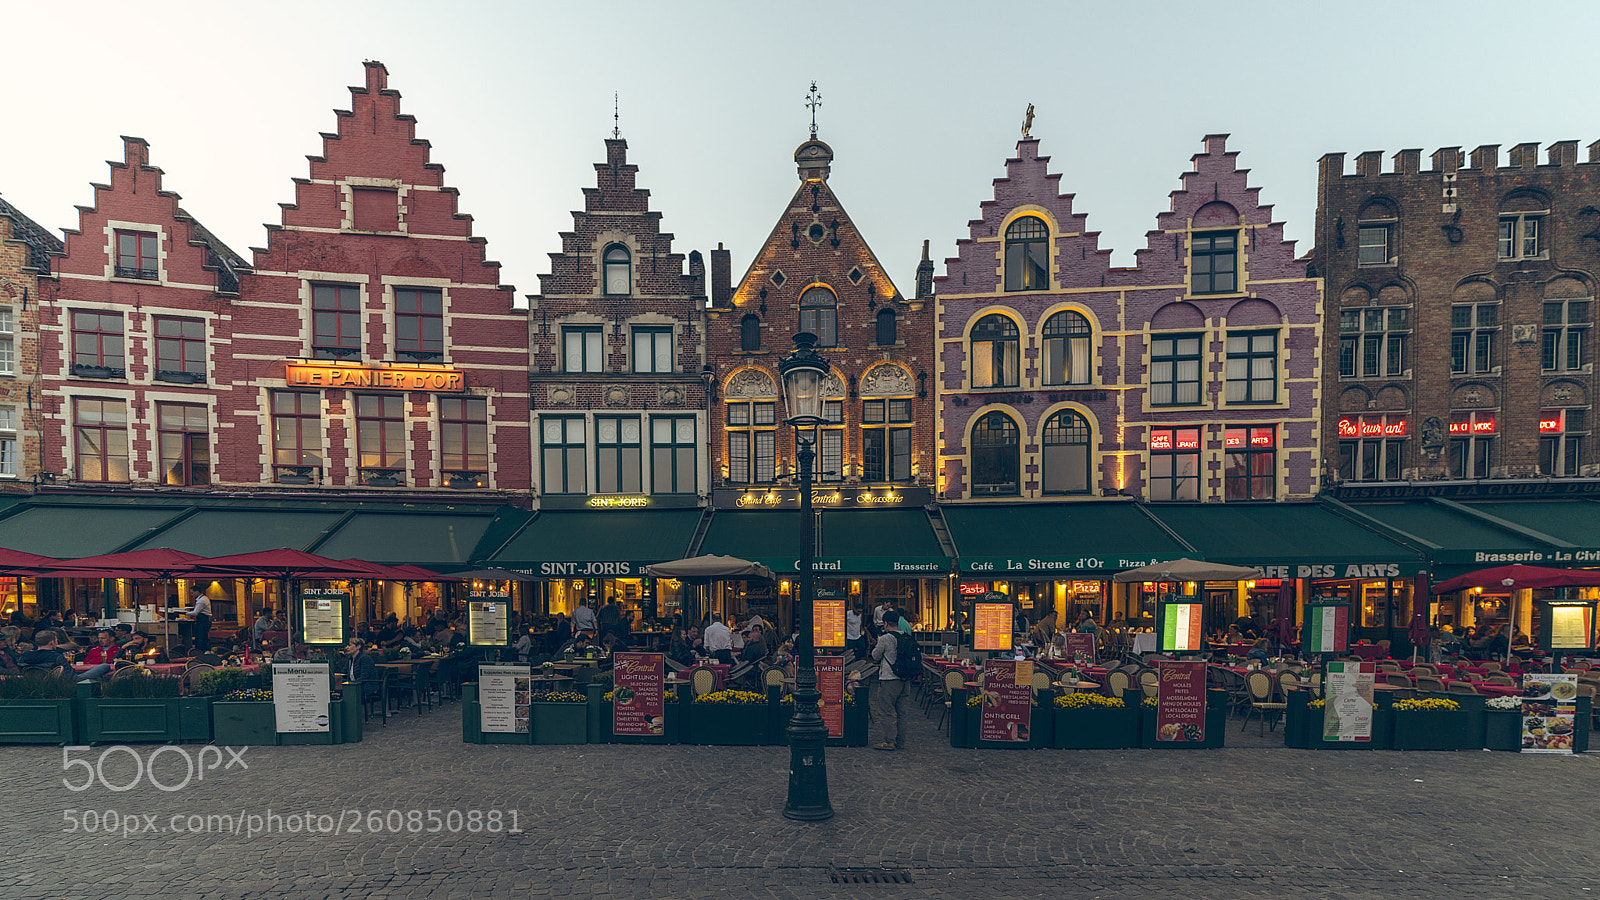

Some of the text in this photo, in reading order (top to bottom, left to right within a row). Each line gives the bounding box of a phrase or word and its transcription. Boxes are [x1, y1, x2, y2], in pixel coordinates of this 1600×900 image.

[295, 370, 460, 390] LE PANIER D'OR
[1339, 486, 1447, 499] RESTAURANT
[1456, 485, 1478, 495] LA
[591, 498, 647, 507] SINT JORIS
[735, 493, 763, 508] Grand
[856, 492, 904, 504] Brasserie
[1475, 550, 1543, 562] Brasserie
[1555, 550, 1572, 561] La
[540, 561, 631, 576] SINT-JORIS
[893, 561, 939, 571] Brasserie
[970, 560, 994, 571] Café
[1006, 559, 1022, 570] La
[1028, 558, 1071, 570] Sirene
[1075, 557, 1105, 569] d'Or
[1118, 558, 1146, 569] Pizza
[1297, 564, 1336, 578] DES
[1344, 563, 1400, 577] ARTS
[469, 590, 486, 598] SINT
[1074, 582, 1100, 593] Pizza
[626, 659, 657, 674] Central
[1162, 668, 1193, 682] Central
